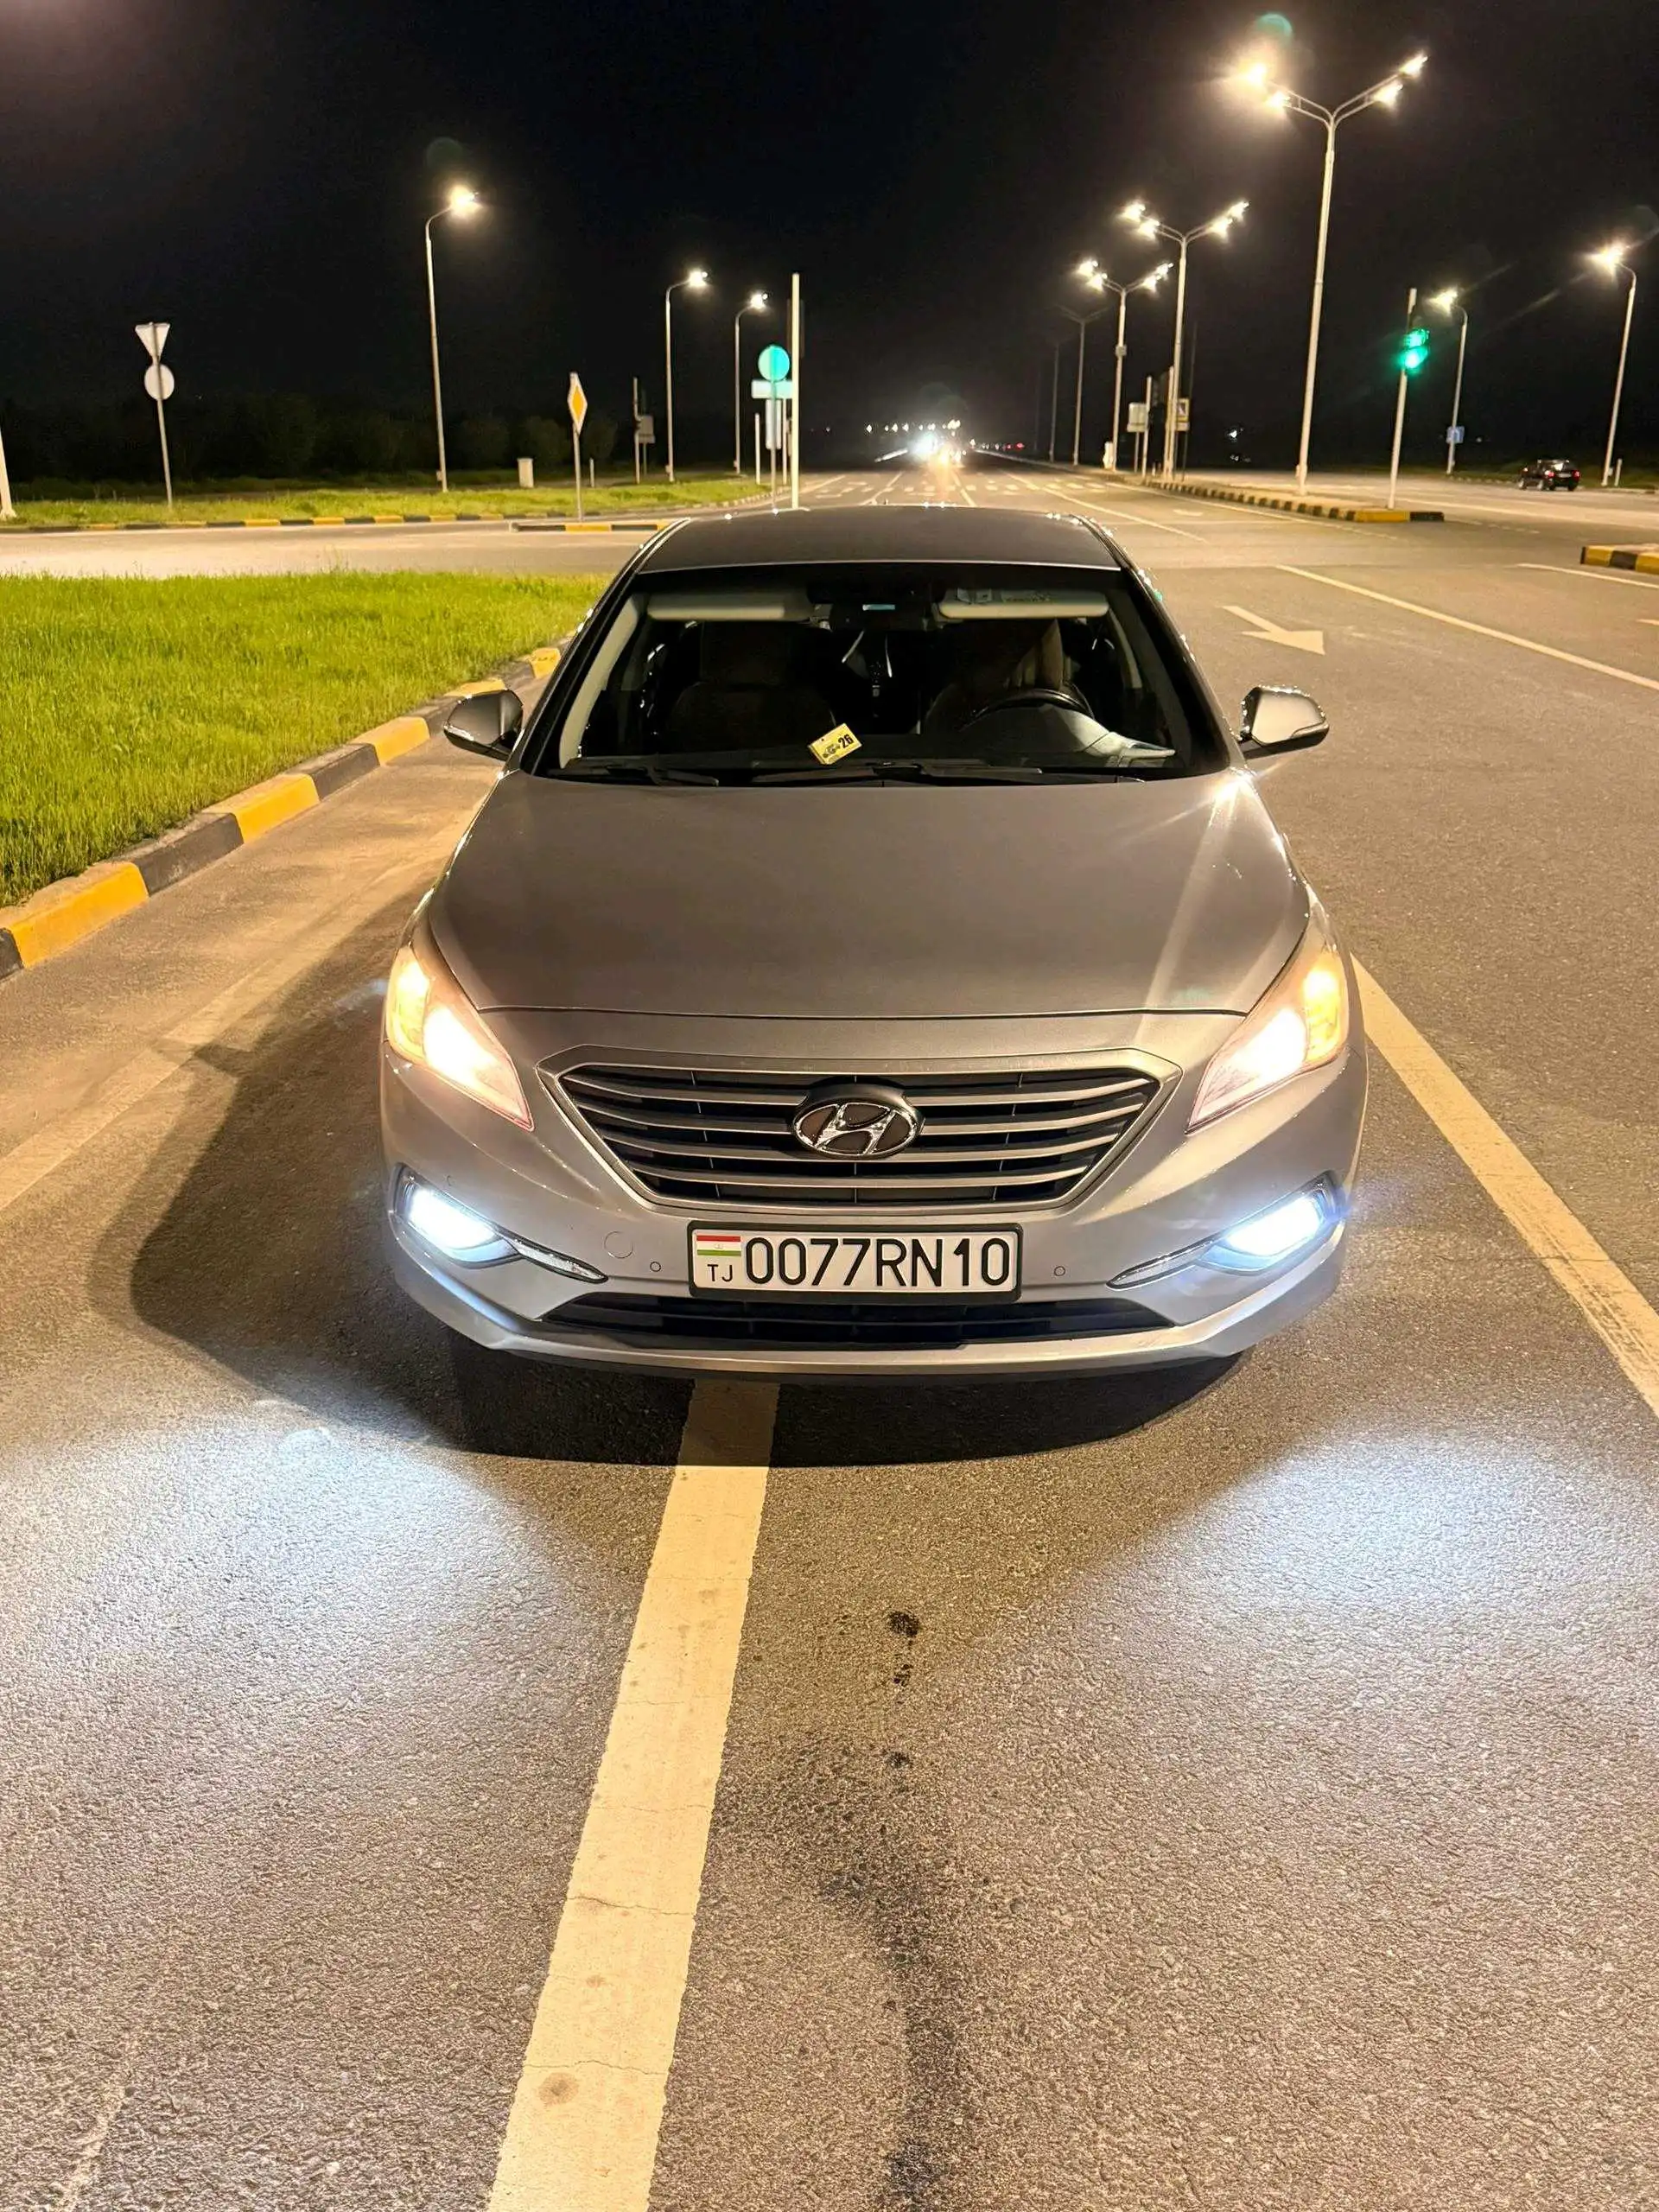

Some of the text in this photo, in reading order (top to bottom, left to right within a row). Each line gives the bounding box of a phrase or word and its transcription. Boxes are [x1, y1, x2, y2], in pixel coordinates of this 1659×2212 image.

[837, 734, 855, 749] 26
[745, 1236, 1010, 1287] 0077RN10
[707, 1263, 734, 1282] TJ
